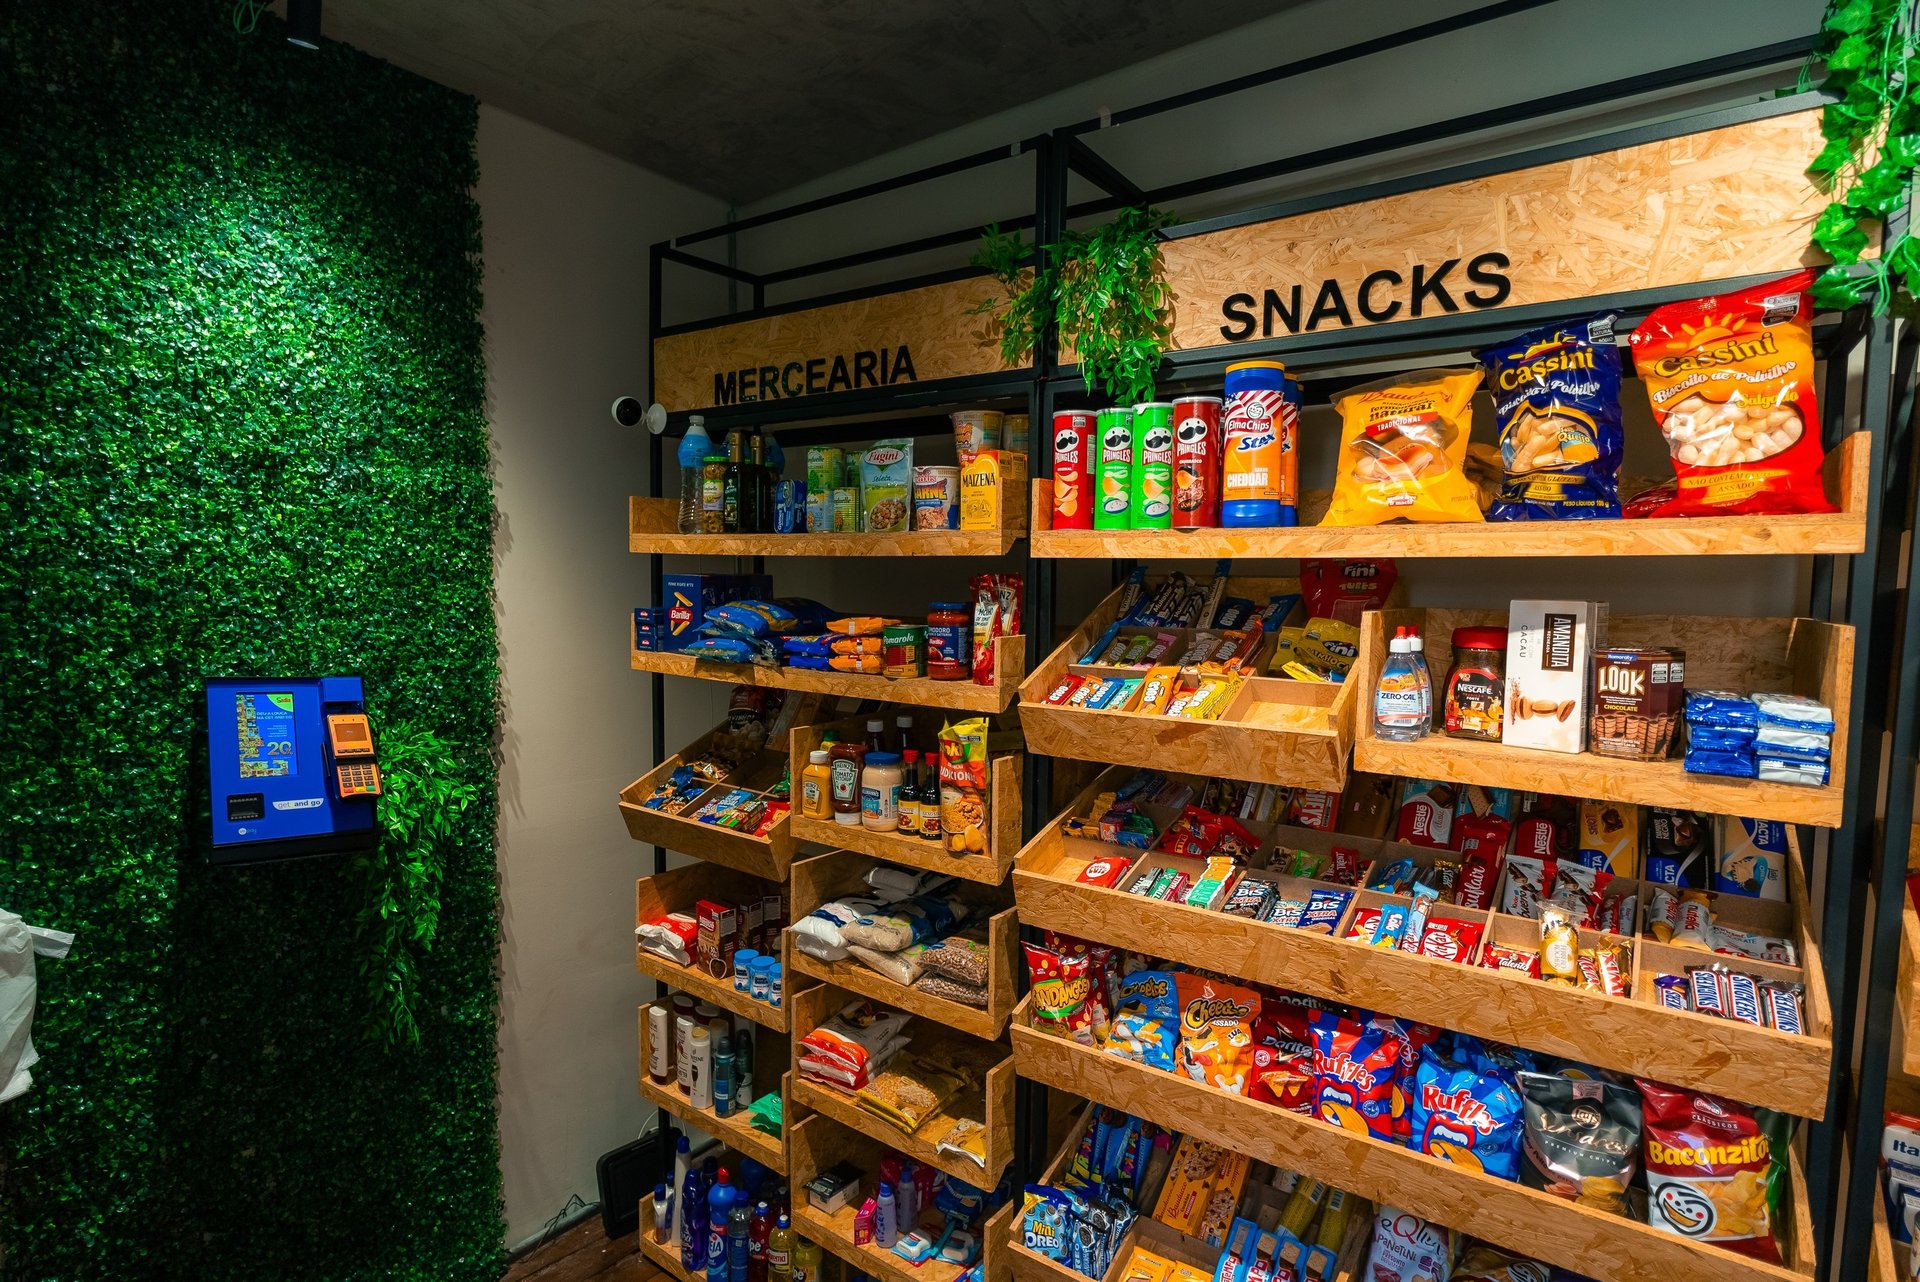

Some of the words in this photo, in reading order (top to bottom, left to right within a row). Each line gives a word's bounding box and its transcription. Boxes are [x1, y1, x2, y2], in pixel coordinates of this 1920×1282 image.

[1219, 252, 1511, 342] SNACKS
[1654, 331, 1779, 377] Cassini
[714, 345, 917, 405] MERCEARIA
[1500, 347, 1595, 391] Cassini
[1653, 374, 1709, 404] Biscoito
[1733, 361, 1796, 383] Polvilho
[1377, 415, 1421, 432] TRADICIONAL
[868, 451, 899, 463] Fugini
[1054, 451, 1079, 465] PRINGLES
[1103, 449, 1131, 463] PRINGLES
[1143, 450, 1172, 465] PRINGLES
[1177, 441, 1206, 456] PRINGLES
[962, 473, 996, 487] MAIZENA
[1227, 472, 1268, 488] CHEDDAR
[1717, 481, 1755, 493] ASSADO
[914, 487, 947, 500] ARNE
[670, 610, 692, 620] Barilla
[1519, 624, 1529, 658] CACAU
[1551, 617, 1571, 668] AMANDITA
[1457, 683, 1494, 695] NESCAFÉ
[1597, 664, 1646, 697] LOOK
[1144, 681, 1161, 702] BOLD
[1603, 704, 1638, 712] CHOCOLATE
[834, 771, 853, 779] TOMATO
[277, 801, 292, 809] get
[294, 799, 309, 807] and
[310, 800, 321, 808] go
[1412, 804, 1428, 836] Nestlé
[1534, 822, 1550, 855] Nestlé
[1130, 877, 1146, 894] HALLS
[1153, 883, 1168, 899] HALL
[1425, 933, 1457, 961] KitKat
[1604, 953, 1626, 996] TWIX
[1694, 972, 1719, 1009] SNICKERS
[1732, 976, 1759, 1023] SNICKERS
[1186, 998, 1250, 1029] Cheetos
[1774, 990, 1802, 1034] SNICKERS
[1262, 1035, 1313, 1058] Dorito
[1313, 1049, 1376, 1092] Ruffles
[1545, 1140, 1584, 1157] PREMIUM
[1589, 1154, 1616, 1165] CHIPS
[1032, 1220, 1055, 1237] Mini
[1025, 1231, 1059, 1248] OREO
